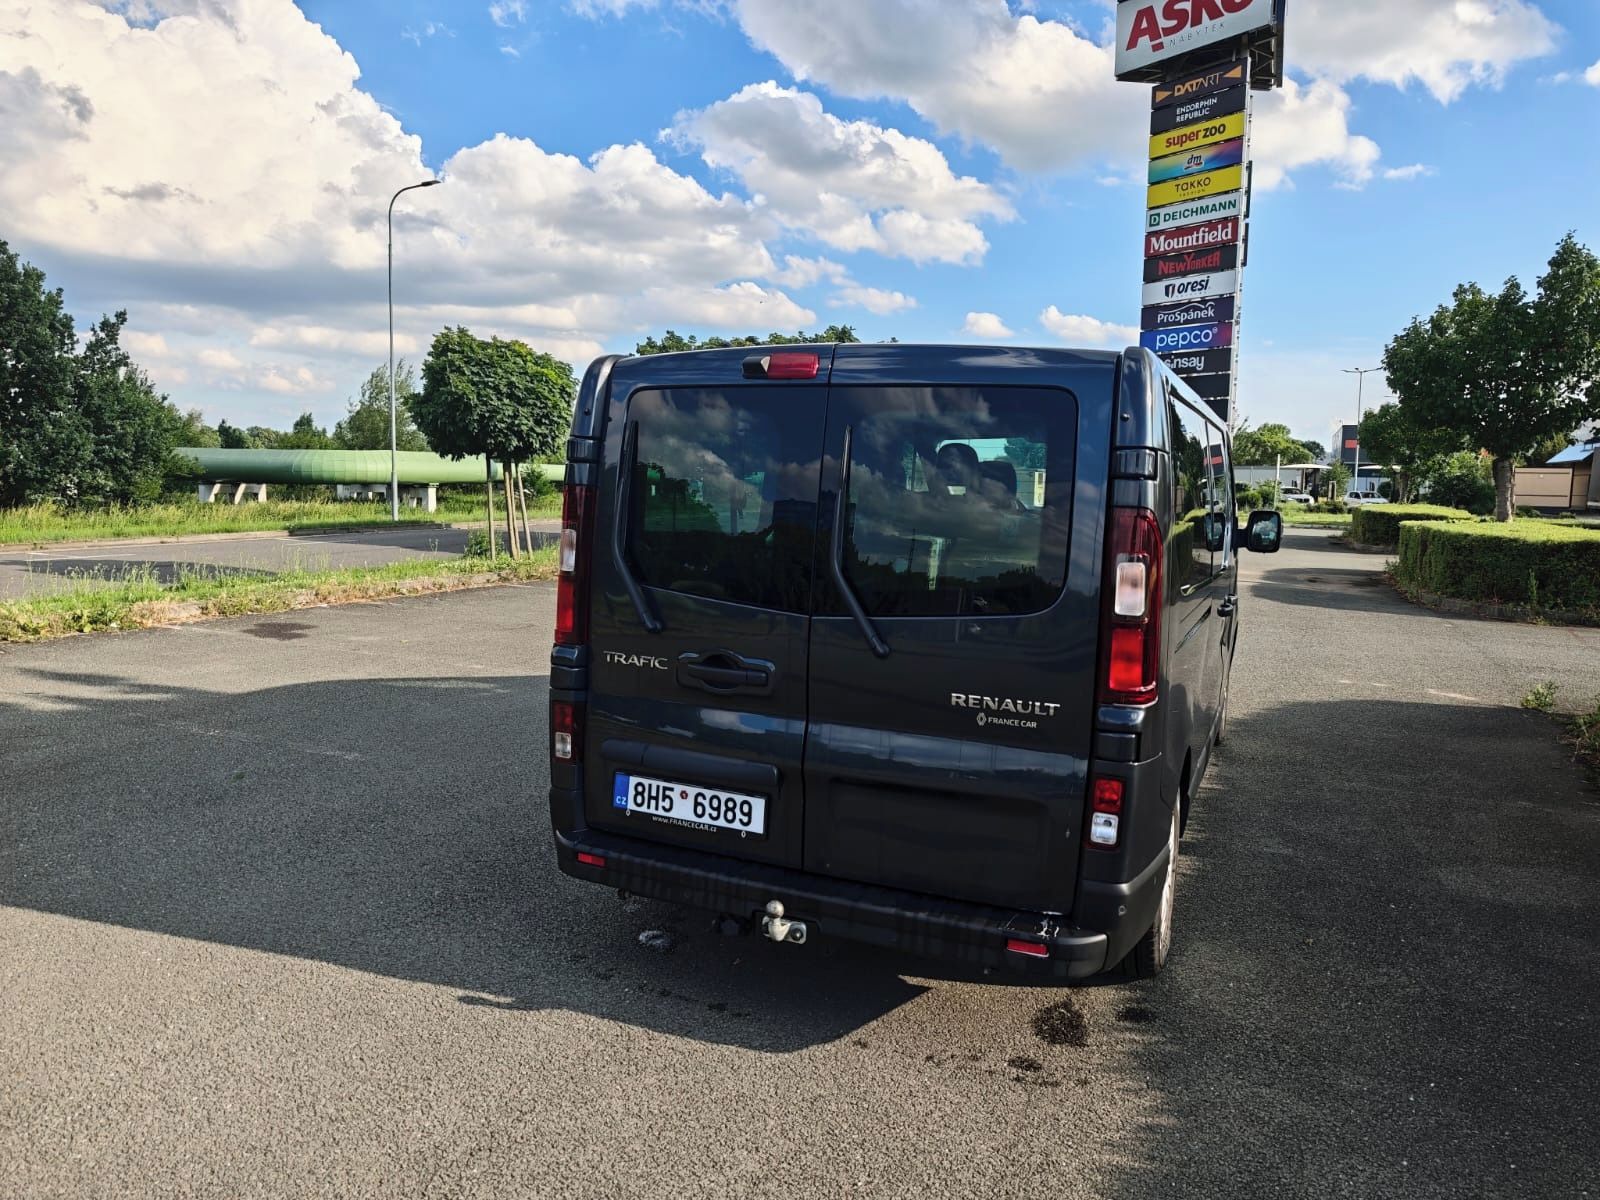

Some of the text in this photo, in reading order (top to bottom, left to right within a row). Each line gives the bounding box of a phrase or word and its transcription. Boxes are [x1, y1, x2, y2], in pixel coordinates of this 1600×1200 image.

[1174, 71, 1224, 97] DATART
[1175, 108, 1211, 123] REPUBLIC
[1176, 97, 1218, 115] ENDORPHIN
[1187, 154, 1202, 165] dm
[1163, 199, 1237, 222] DEICHMANN
[1150, 222, 1232, 253] Mountfield
[1177, 276, 1210, 294] oresi
[1157, 306, 1215, 323] ProSpánek
[603, 650, 668, 670] TRAFIC
[951, 693, 1060, 716] RENAULT
[988, 717, 1038, 729] FRANCE CAR
[615, 781, 753, 827] CZ 8H5 6989
